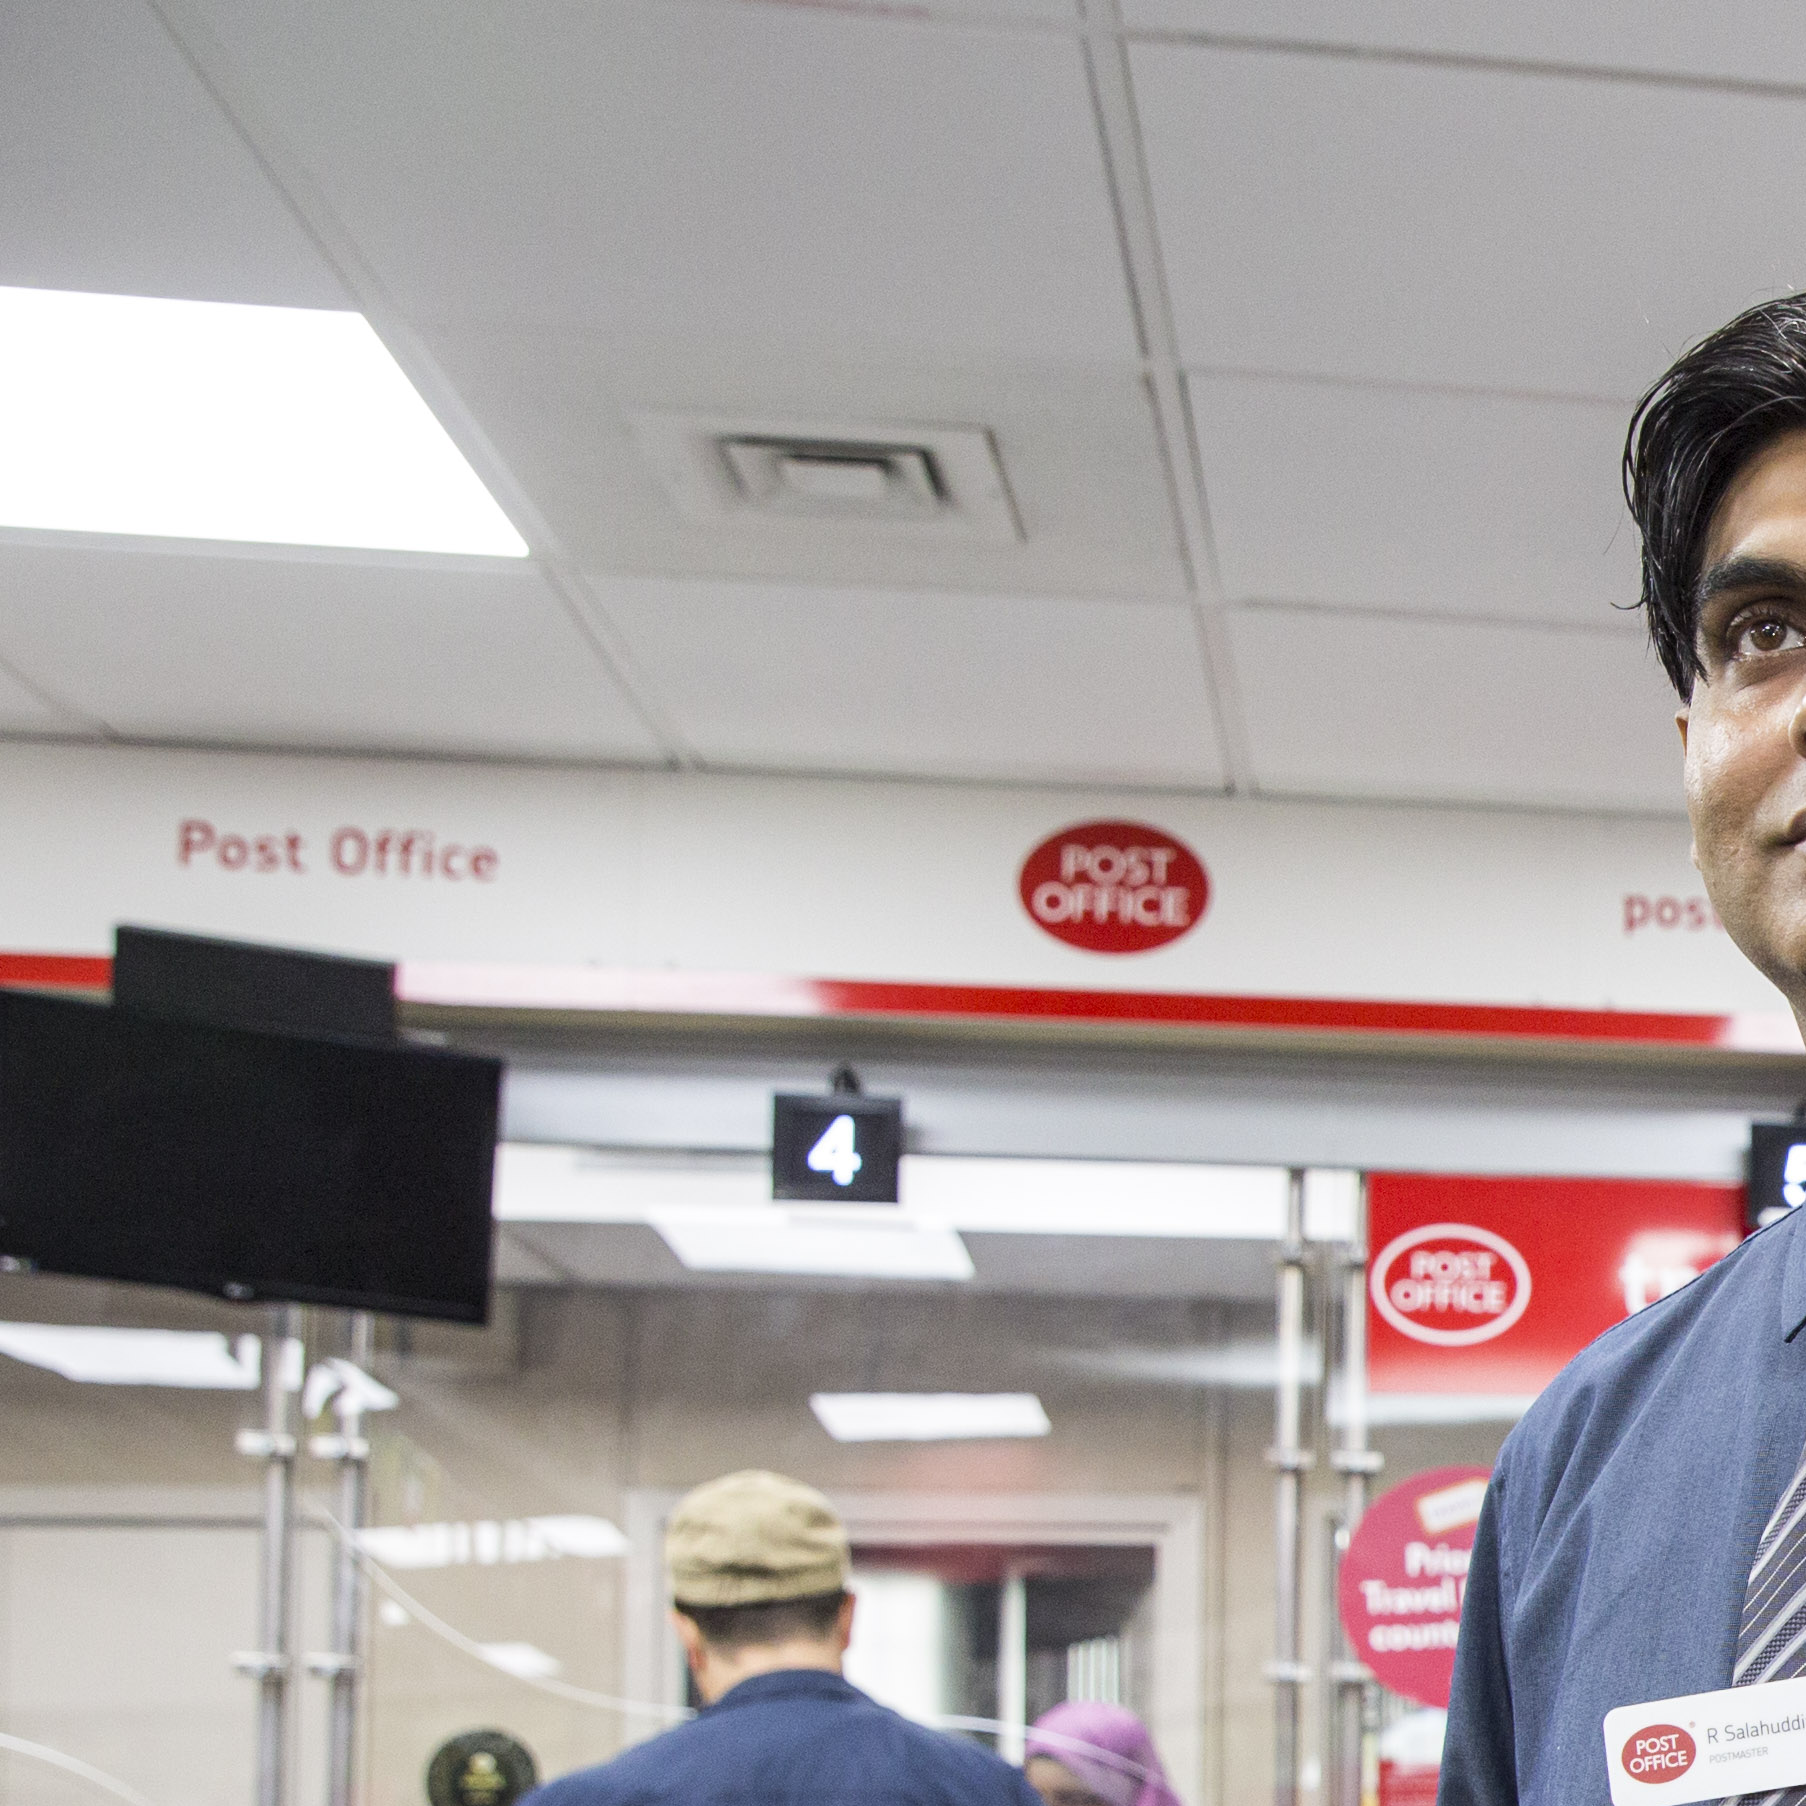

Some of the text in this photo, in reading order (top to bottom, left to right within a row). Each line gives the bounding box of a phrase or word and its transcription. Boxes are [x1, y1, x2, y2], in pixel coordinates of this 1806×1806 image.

[177, 818, 500, 883] Post Office
[1060, 842, 1176, 887] POST
[1031, 880, 1191, 928] OFFICE
[806, 1113, 862, 1186] 4
[1411, 1251, 1494, 1282] POST
[1391, 1278, 1506, 1314] OFFICE
[1636, 1733, 1680, 1756] POST
[1706, 1727, 1719, 1745] R
[1629, 1750, 1689, 1774] OFFICE
[1709, 1746, 1769, 1765] POSTMASTER
